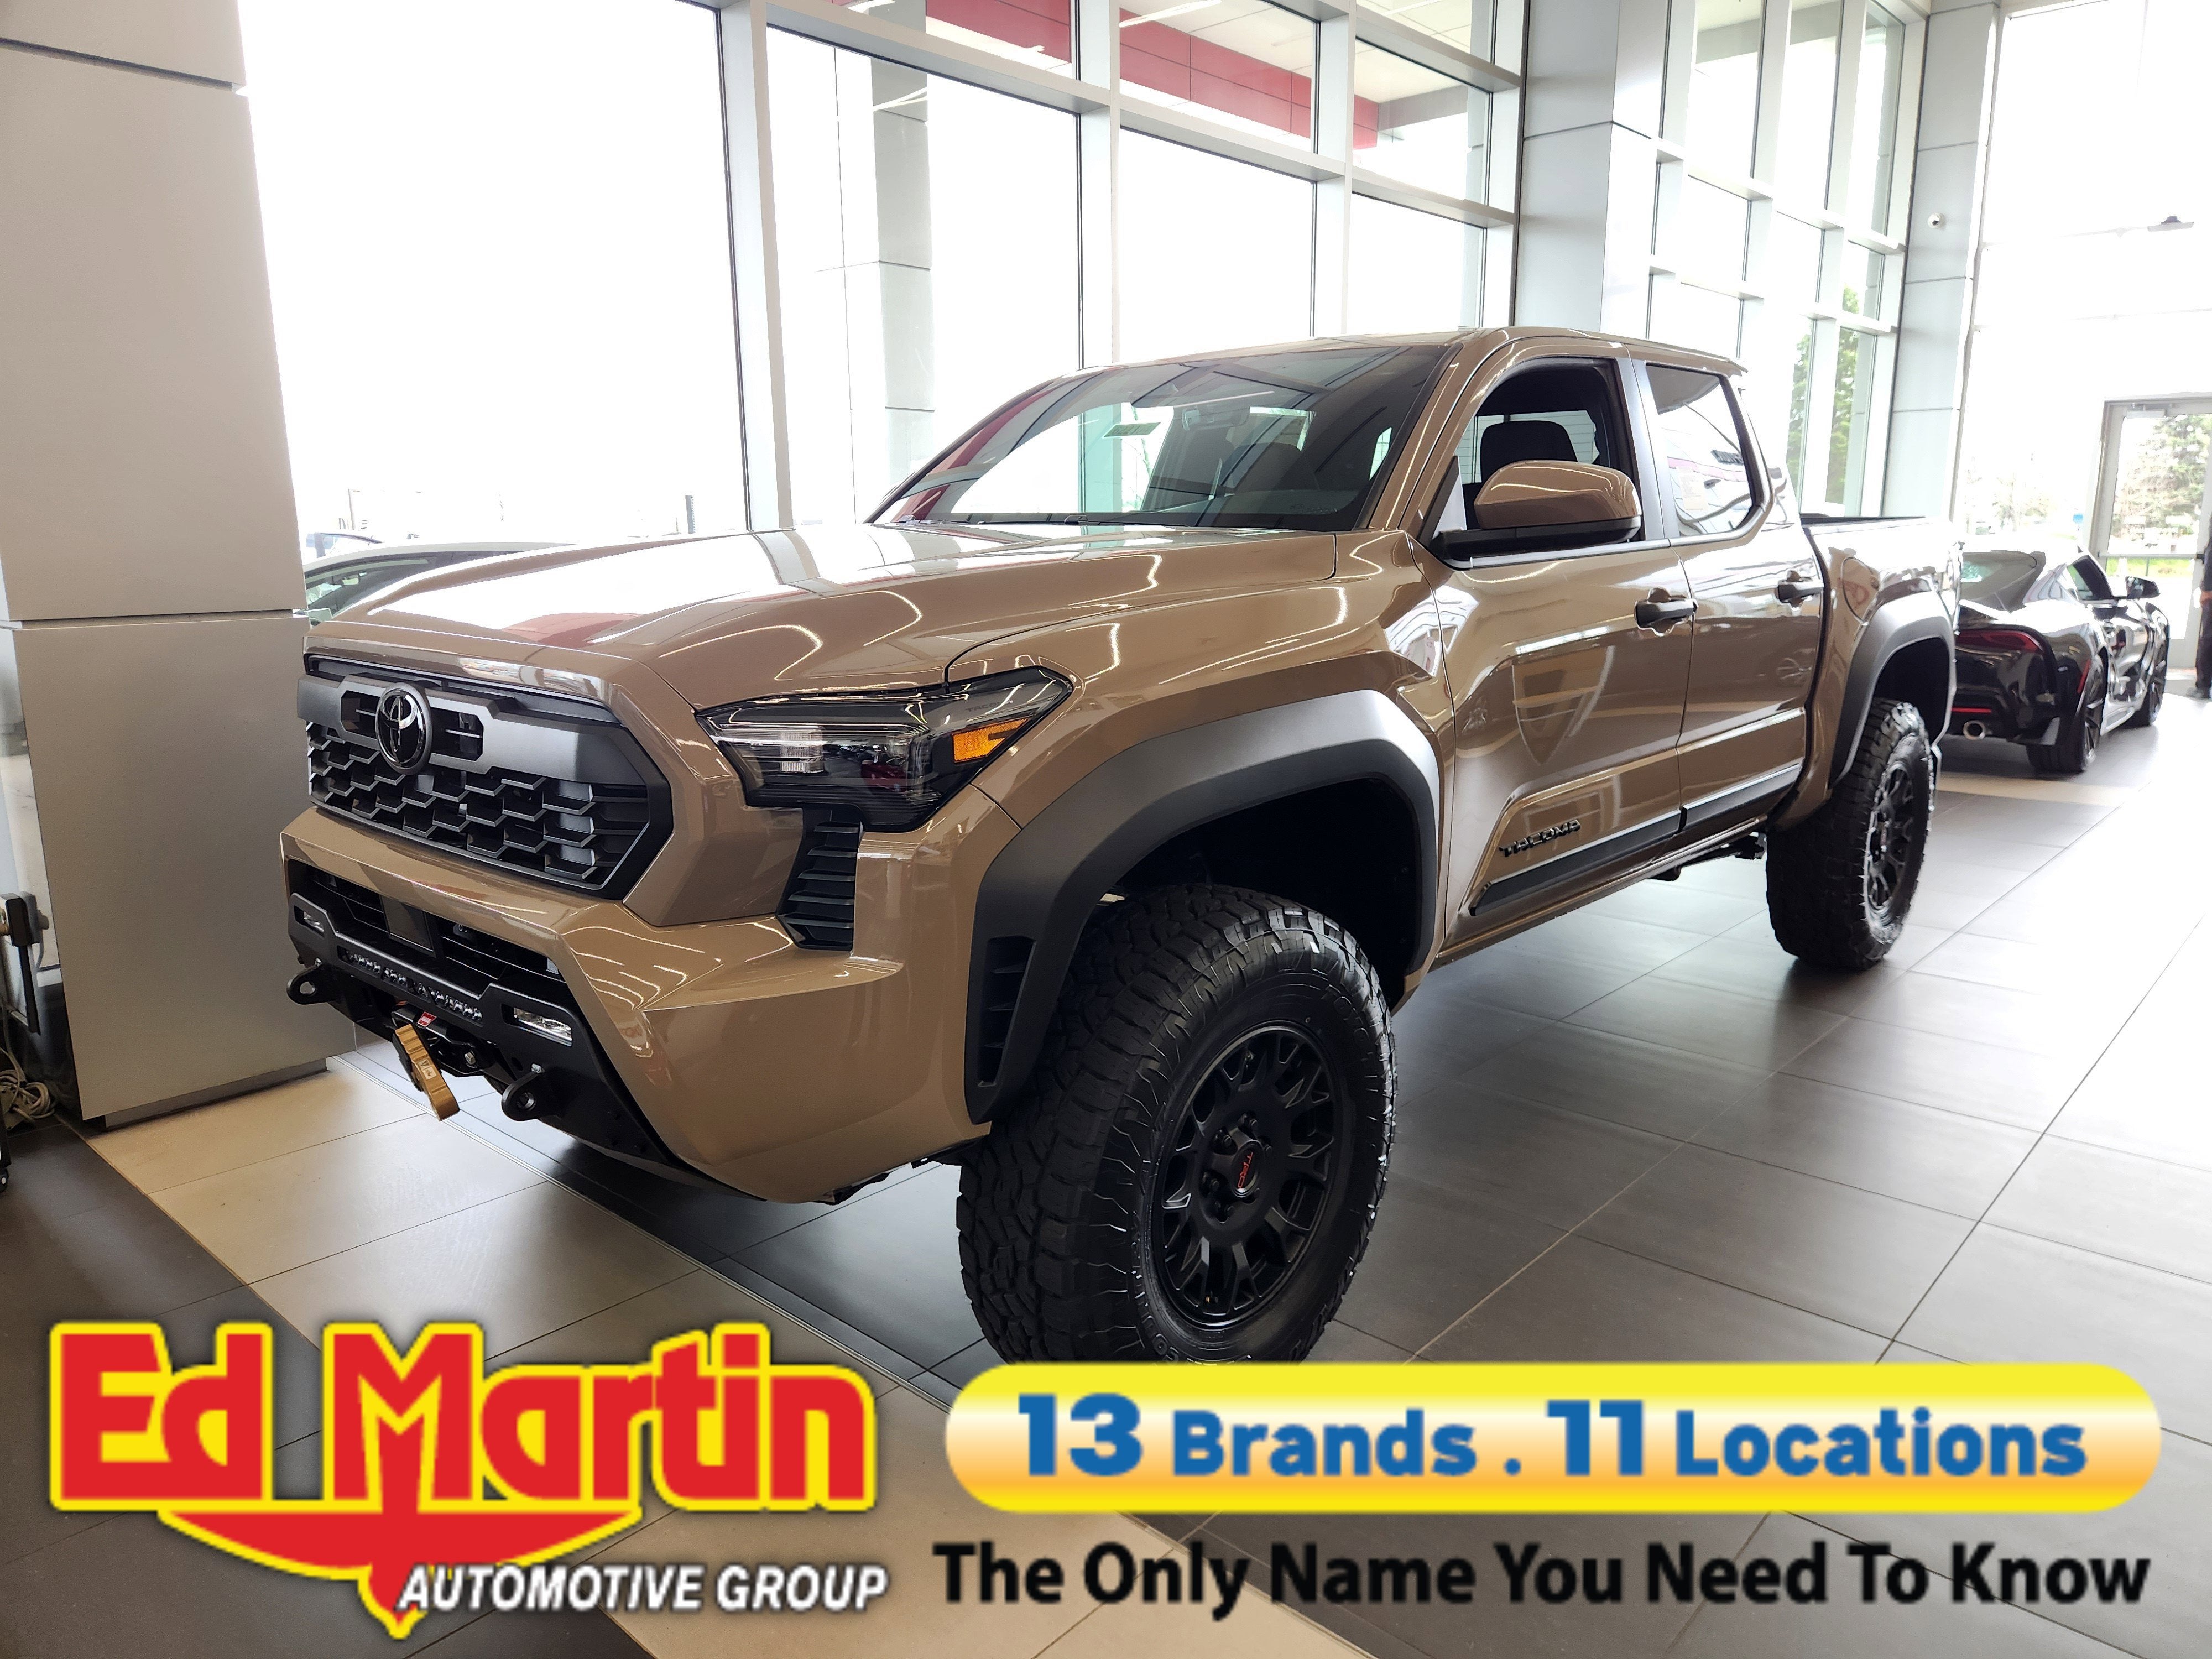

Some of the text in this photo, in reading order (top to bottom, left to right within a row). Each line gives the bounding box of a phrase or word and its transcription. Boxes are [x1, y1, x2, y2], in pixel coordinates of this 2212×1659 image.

[965, 700, 1013, 712] TACO
[1498, 818, 1581, 858] TACOMA
[1237, 1151, 1254, 1188] TRD
